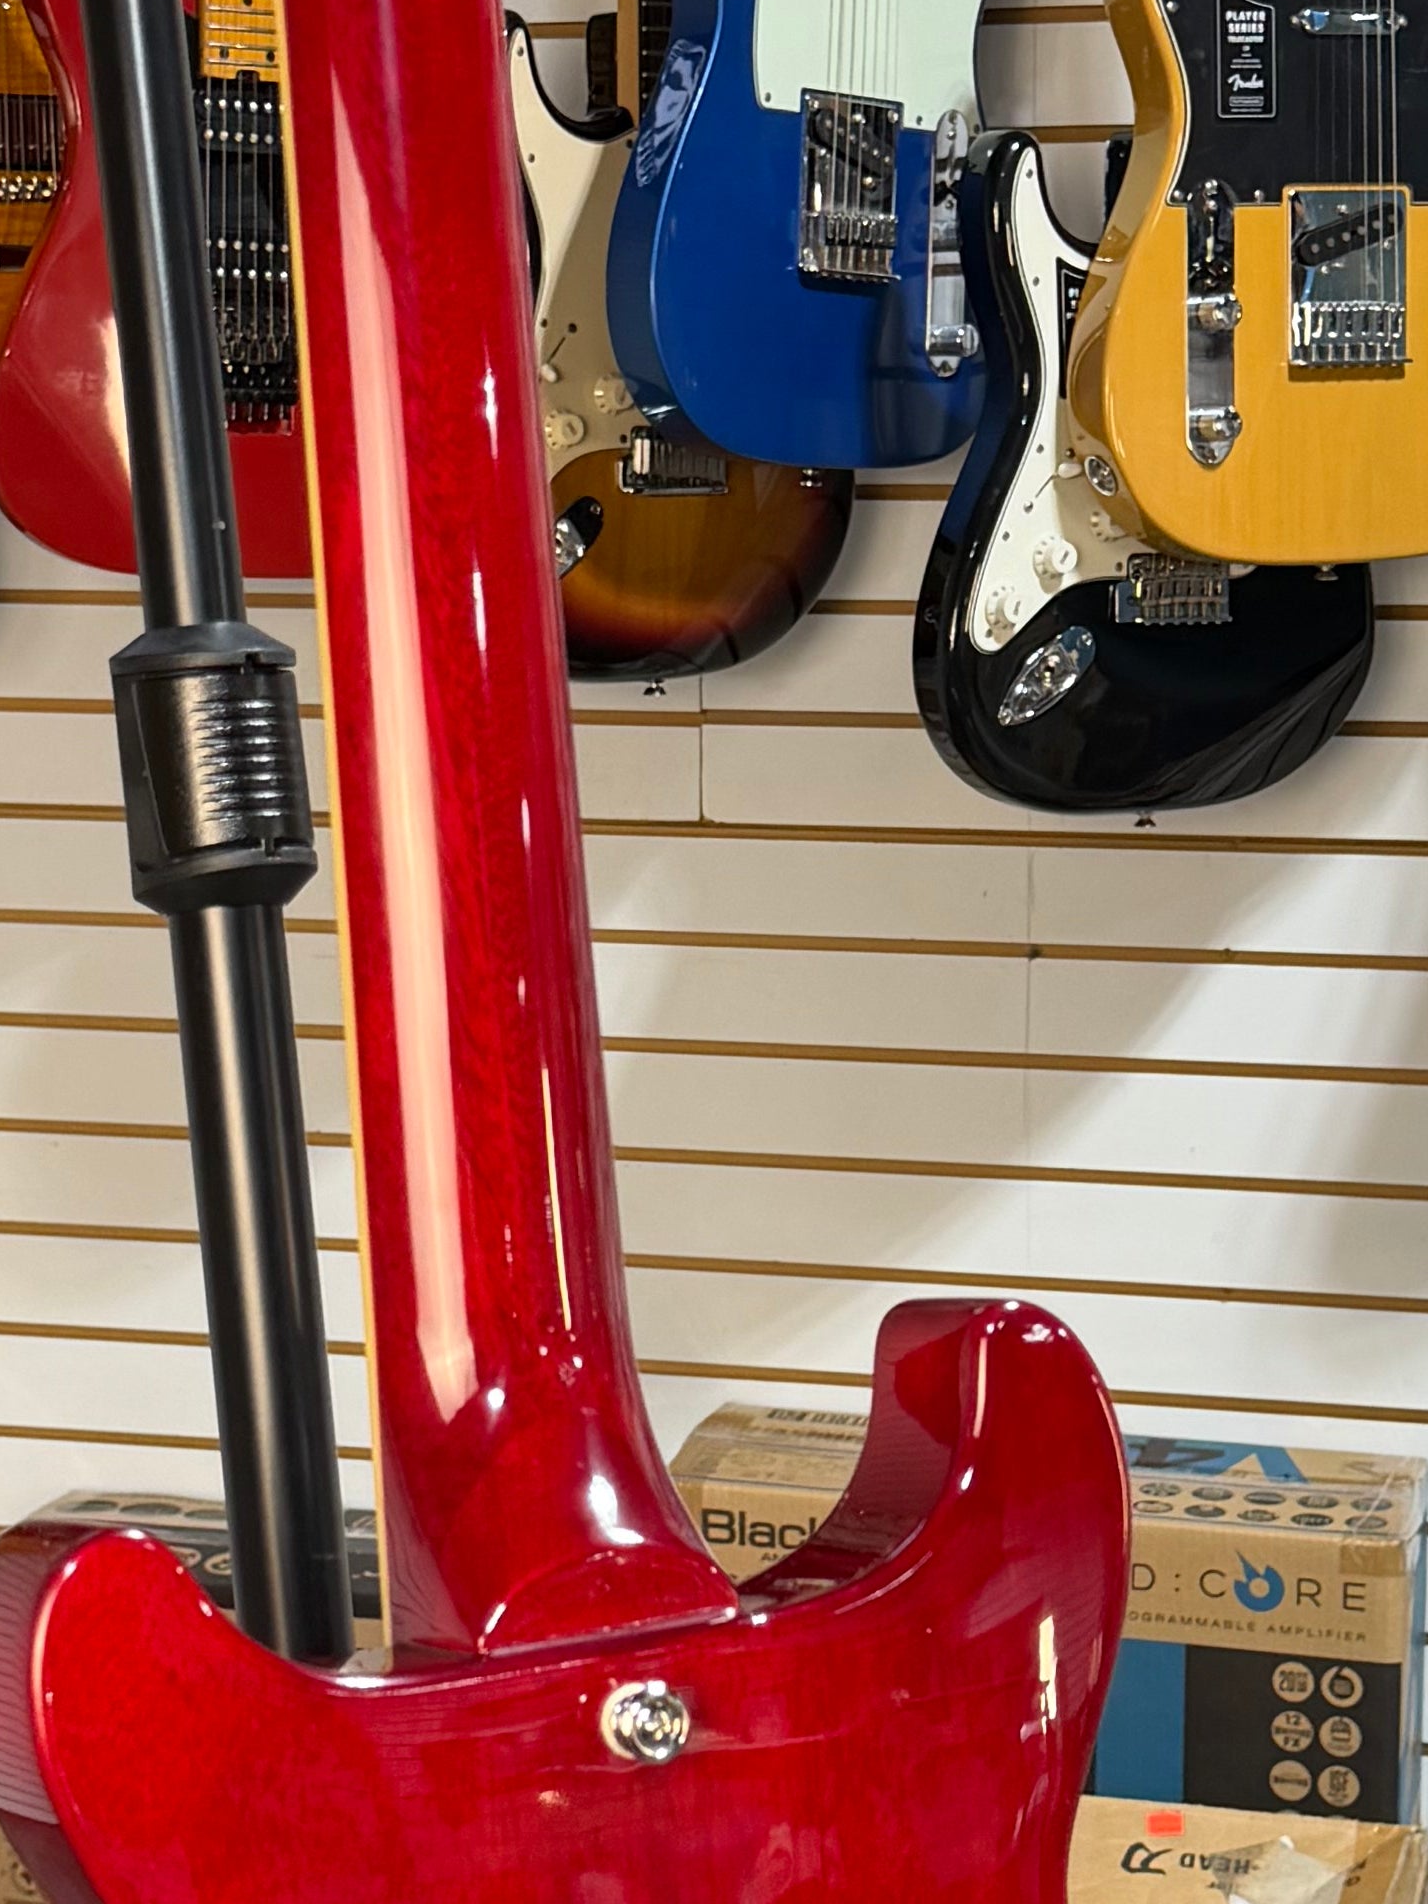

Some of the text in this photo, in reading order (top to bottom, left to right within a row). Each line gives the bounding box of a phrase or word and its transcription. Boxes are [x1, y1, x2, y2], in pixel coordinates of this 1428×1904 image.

[1225, 10, 1266, 22] PLAYER
[1227, 23, 1265, 34] SERIES
[1227, 73, 1264, 92] Fender
[1128, 1610, 1368, 1643] OGRAMMABLE AMPLIFIER
[1284, 1714, 1301, 1725] 12
